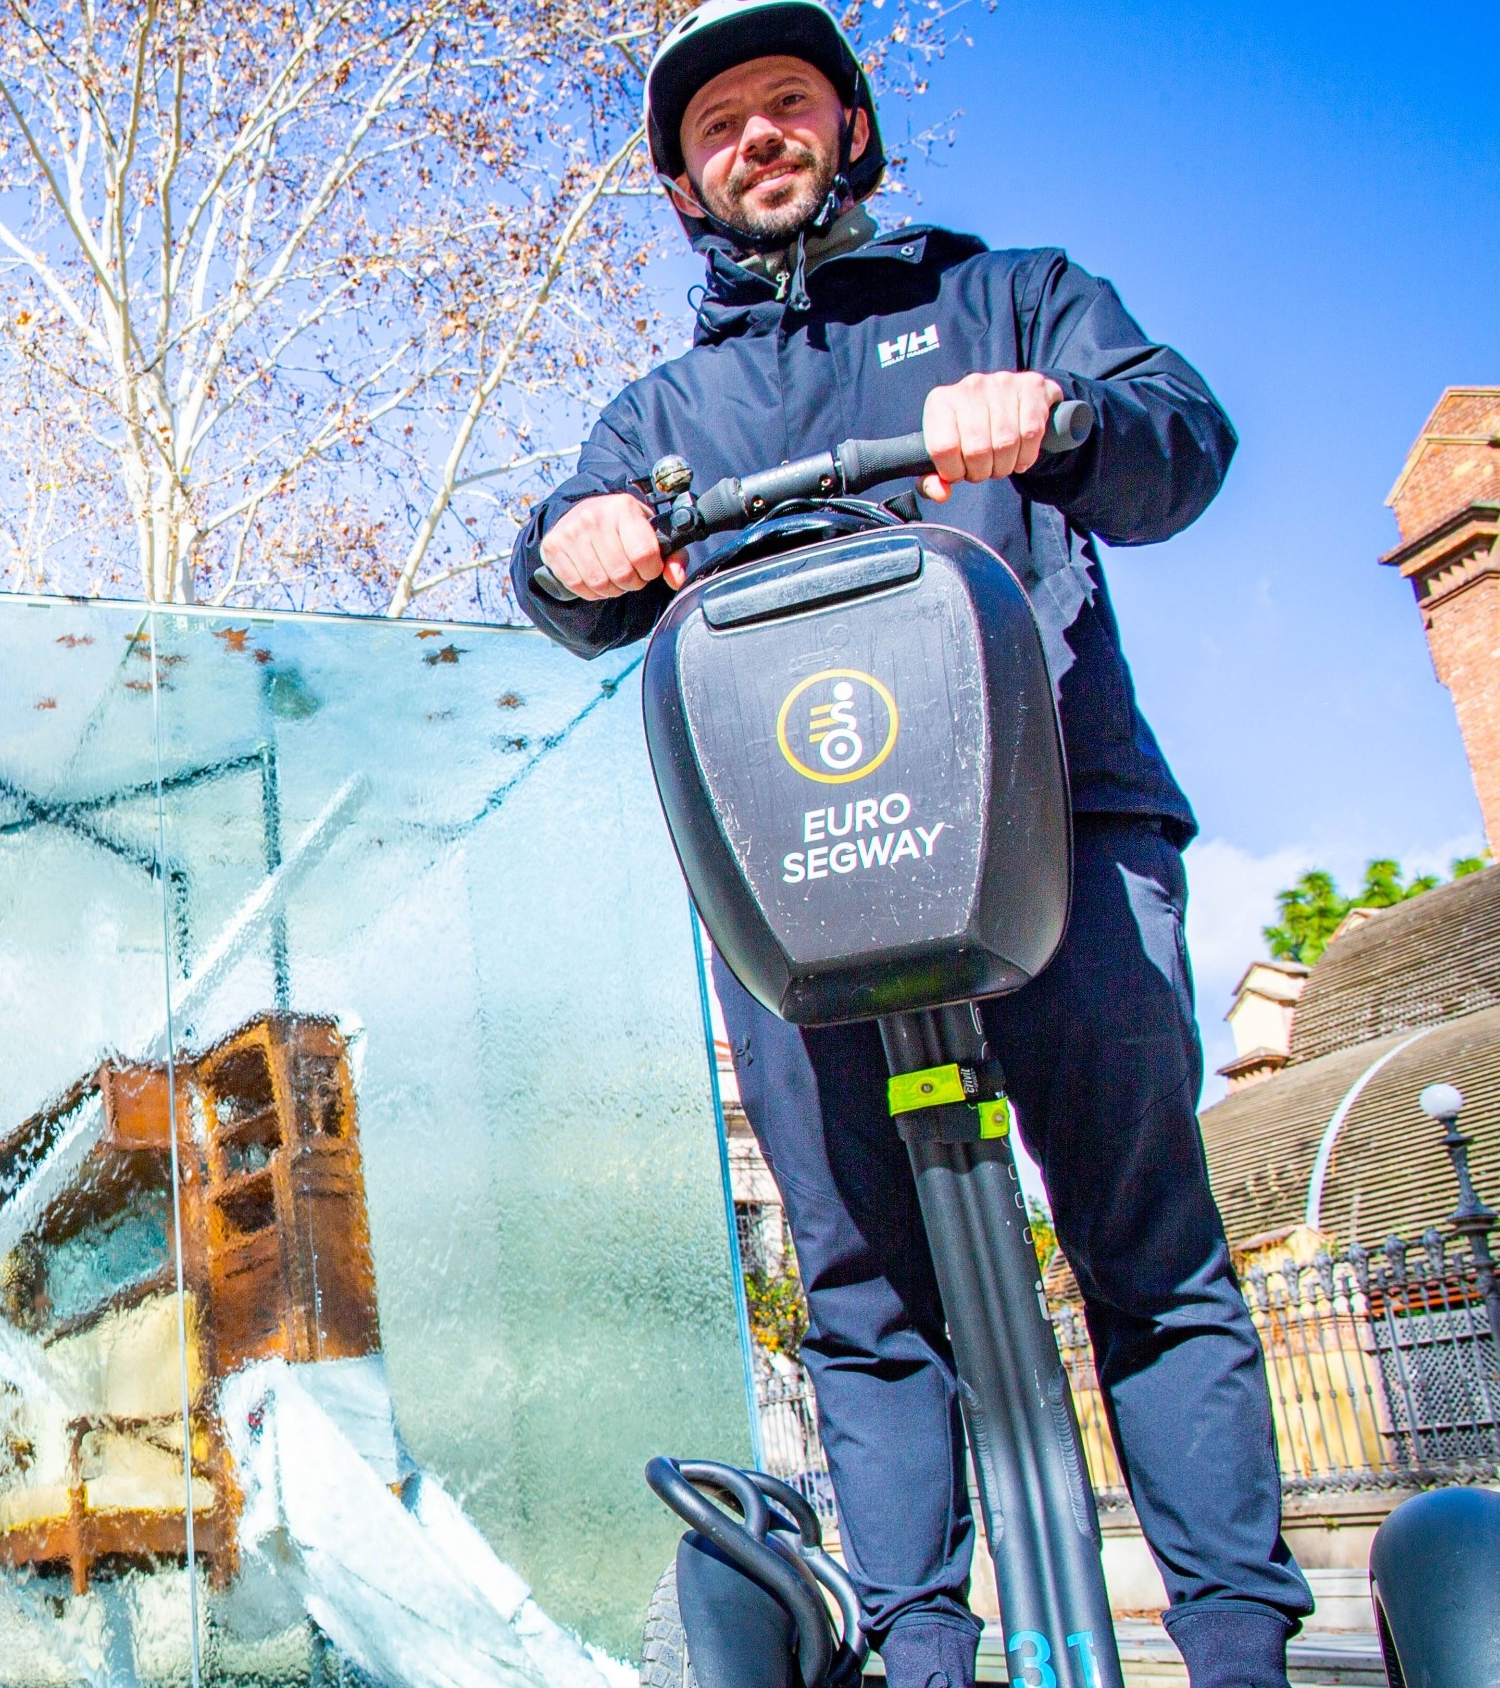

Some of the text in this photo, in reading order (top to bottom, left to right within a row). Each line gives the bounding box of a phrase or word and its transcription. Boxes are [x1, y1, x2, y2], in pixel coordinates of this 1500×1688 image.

[803, 792, 911, 843] EURO
[782, 821, 945, 883] SEGWAY
[1008, 1630, 1102, 1688] 31
